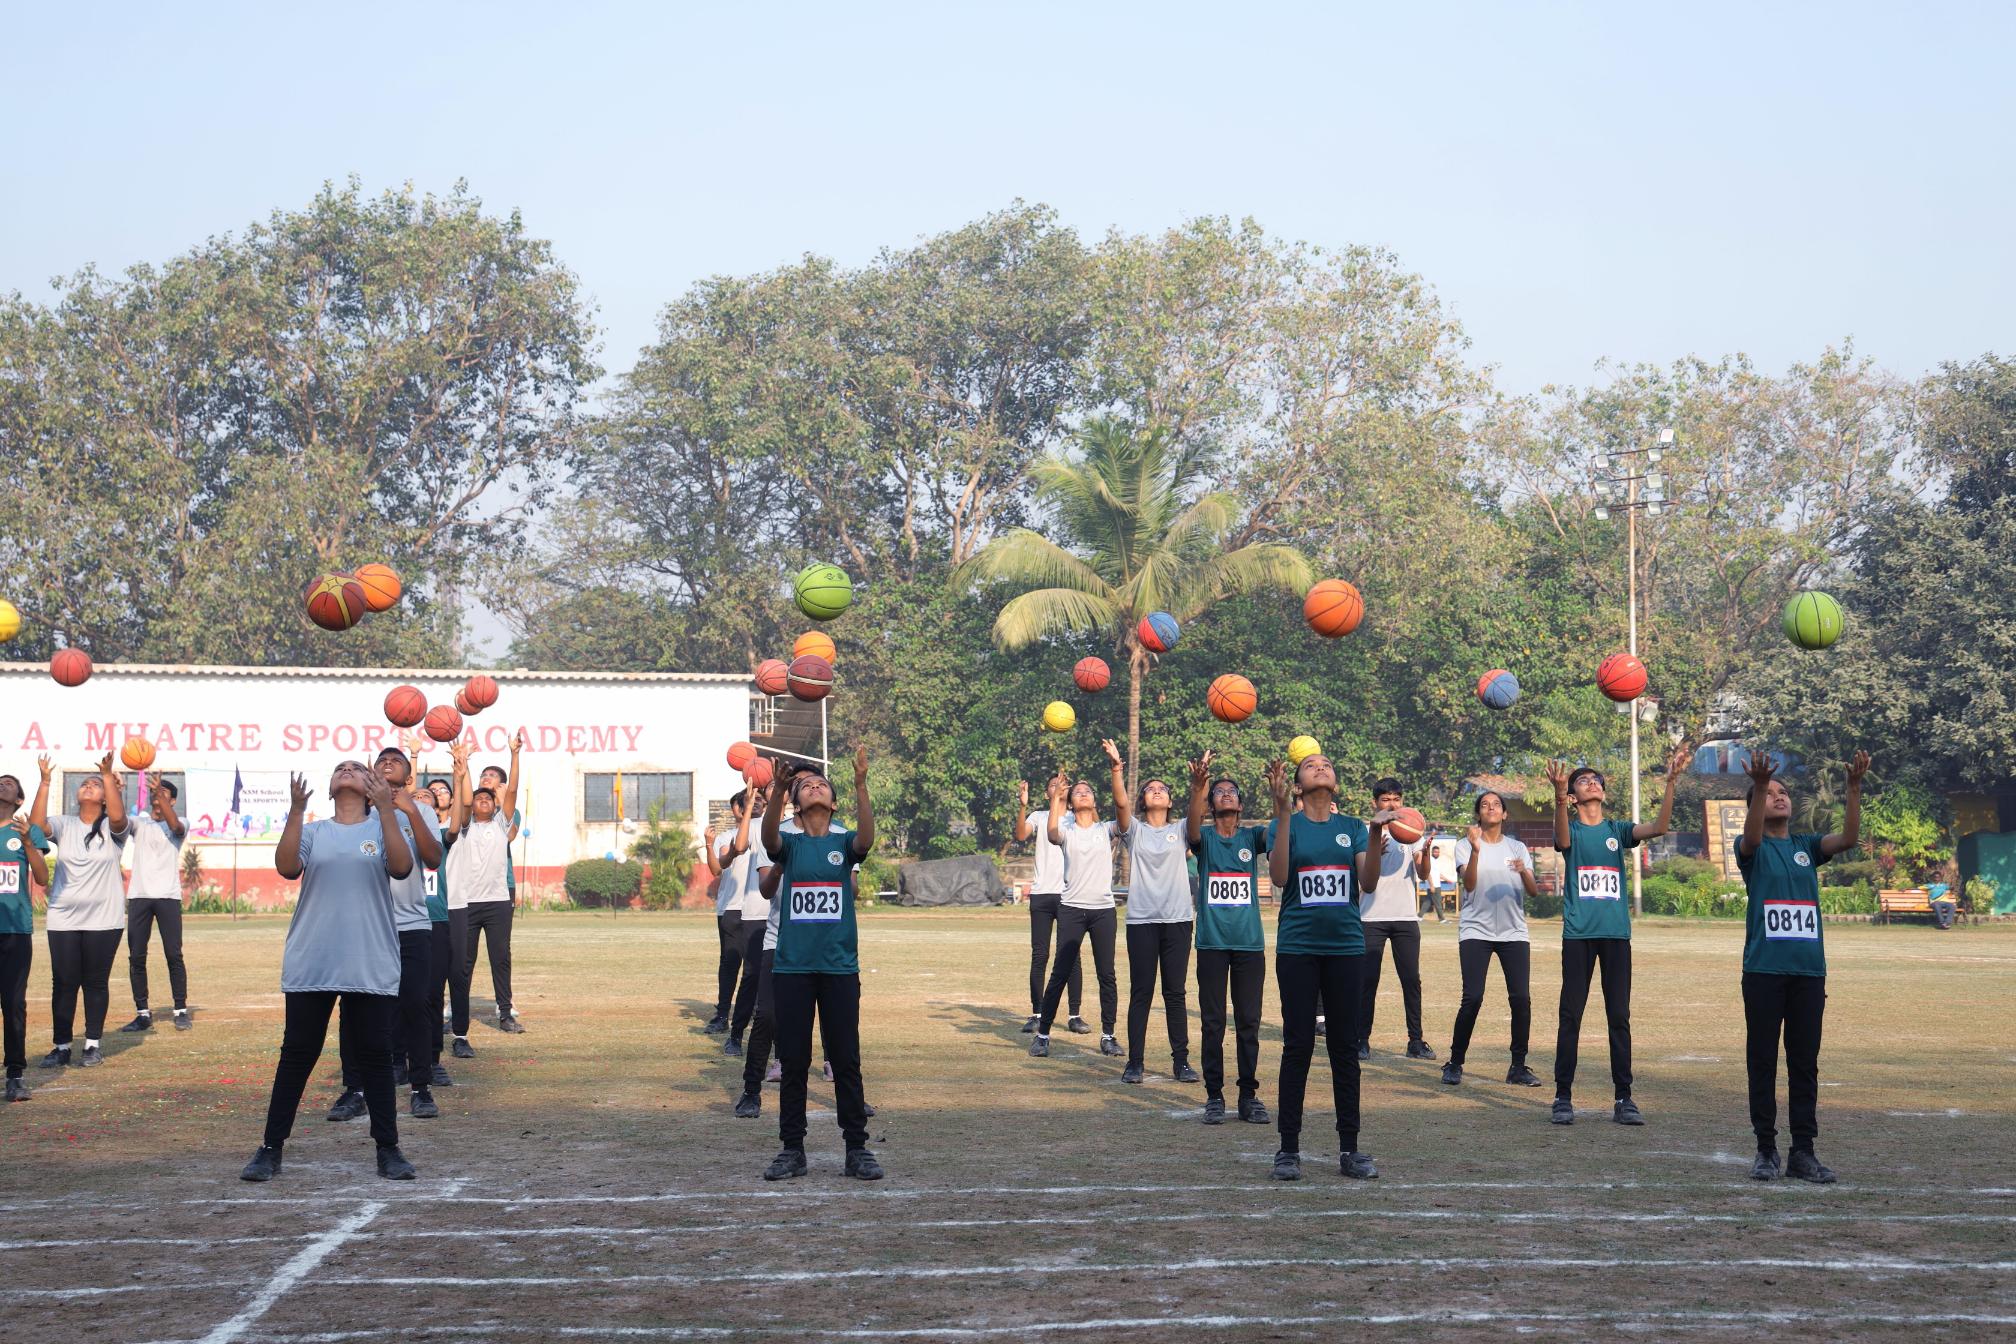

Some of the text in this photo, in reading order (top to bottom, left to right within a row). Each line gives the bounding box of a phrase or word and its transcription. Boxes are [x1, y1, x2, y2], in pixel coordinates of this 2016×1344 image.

[20, 721, 644, 753] A. MHATRE SPORTS ACADEMY
[1210, 880, 1249, 900] 0803
[1302, 874, 1346, 898] 0831
[1580, 873, 1618, 893] 0813
[792, 891, 840, 914] 0823
[1767, 909, 1815, 933] 0814
